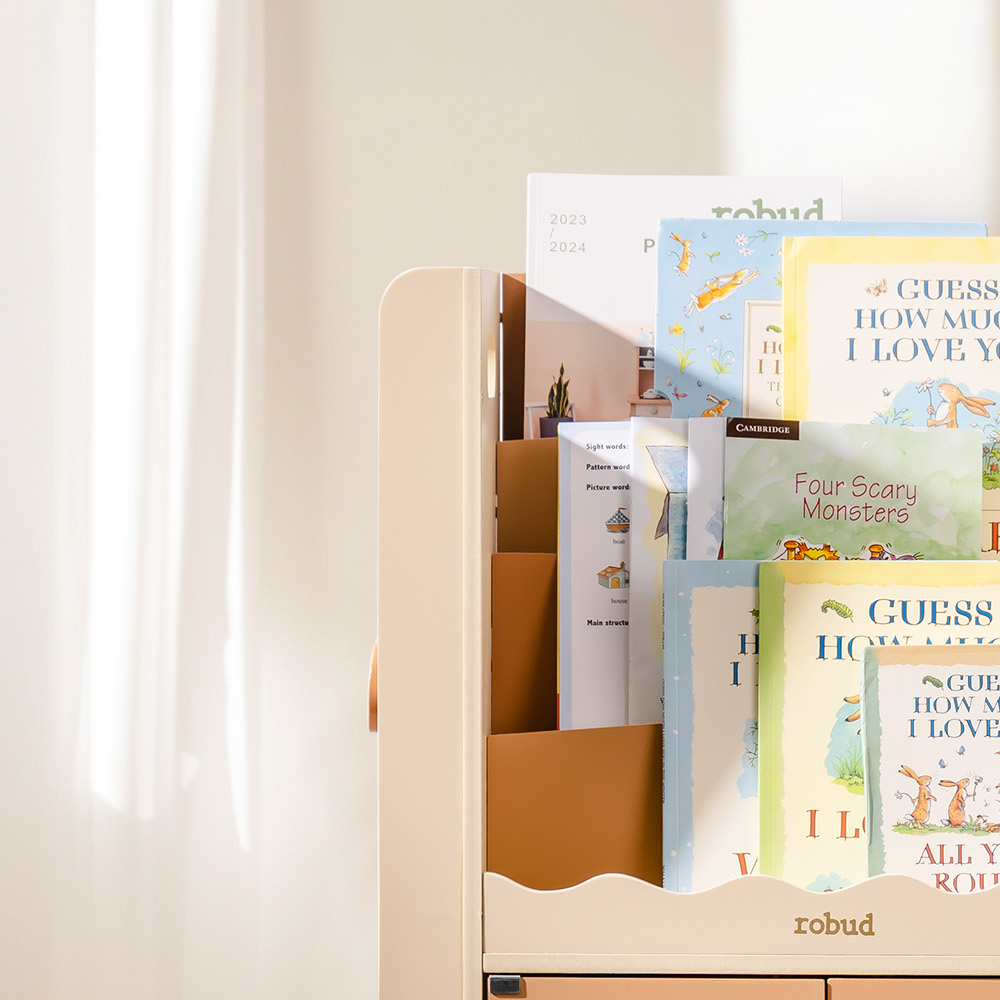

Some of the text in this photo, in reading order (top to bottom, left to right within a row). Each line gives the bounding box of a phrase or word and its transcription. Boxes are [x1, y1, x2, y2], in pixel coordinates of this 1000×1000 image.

[550, 213, 587, 225] 2023
[549, 241, 587, 253] 2024
[897, 278, 999, 301] GUESS
[853, 308, 934, 331] HOW
[846, 338, 858, 362] I
[871, 338, 966, 363] LOVE
[735, 423, 790, 433] CAMBRIDGE
[586, 442, 604, 451] Sight
[794, 472, 918, 506] Four Scary
[802, 497, 909, 523] Monsters
[869, 598, 993, 626] GUESS
[913, 696, 975, 714] HOW
[907, 718, 918, 739] I
[806, 808, 866, 841] I L
[916, 843, 972, 866] ALL
[794, 911, 875, 936] robud
